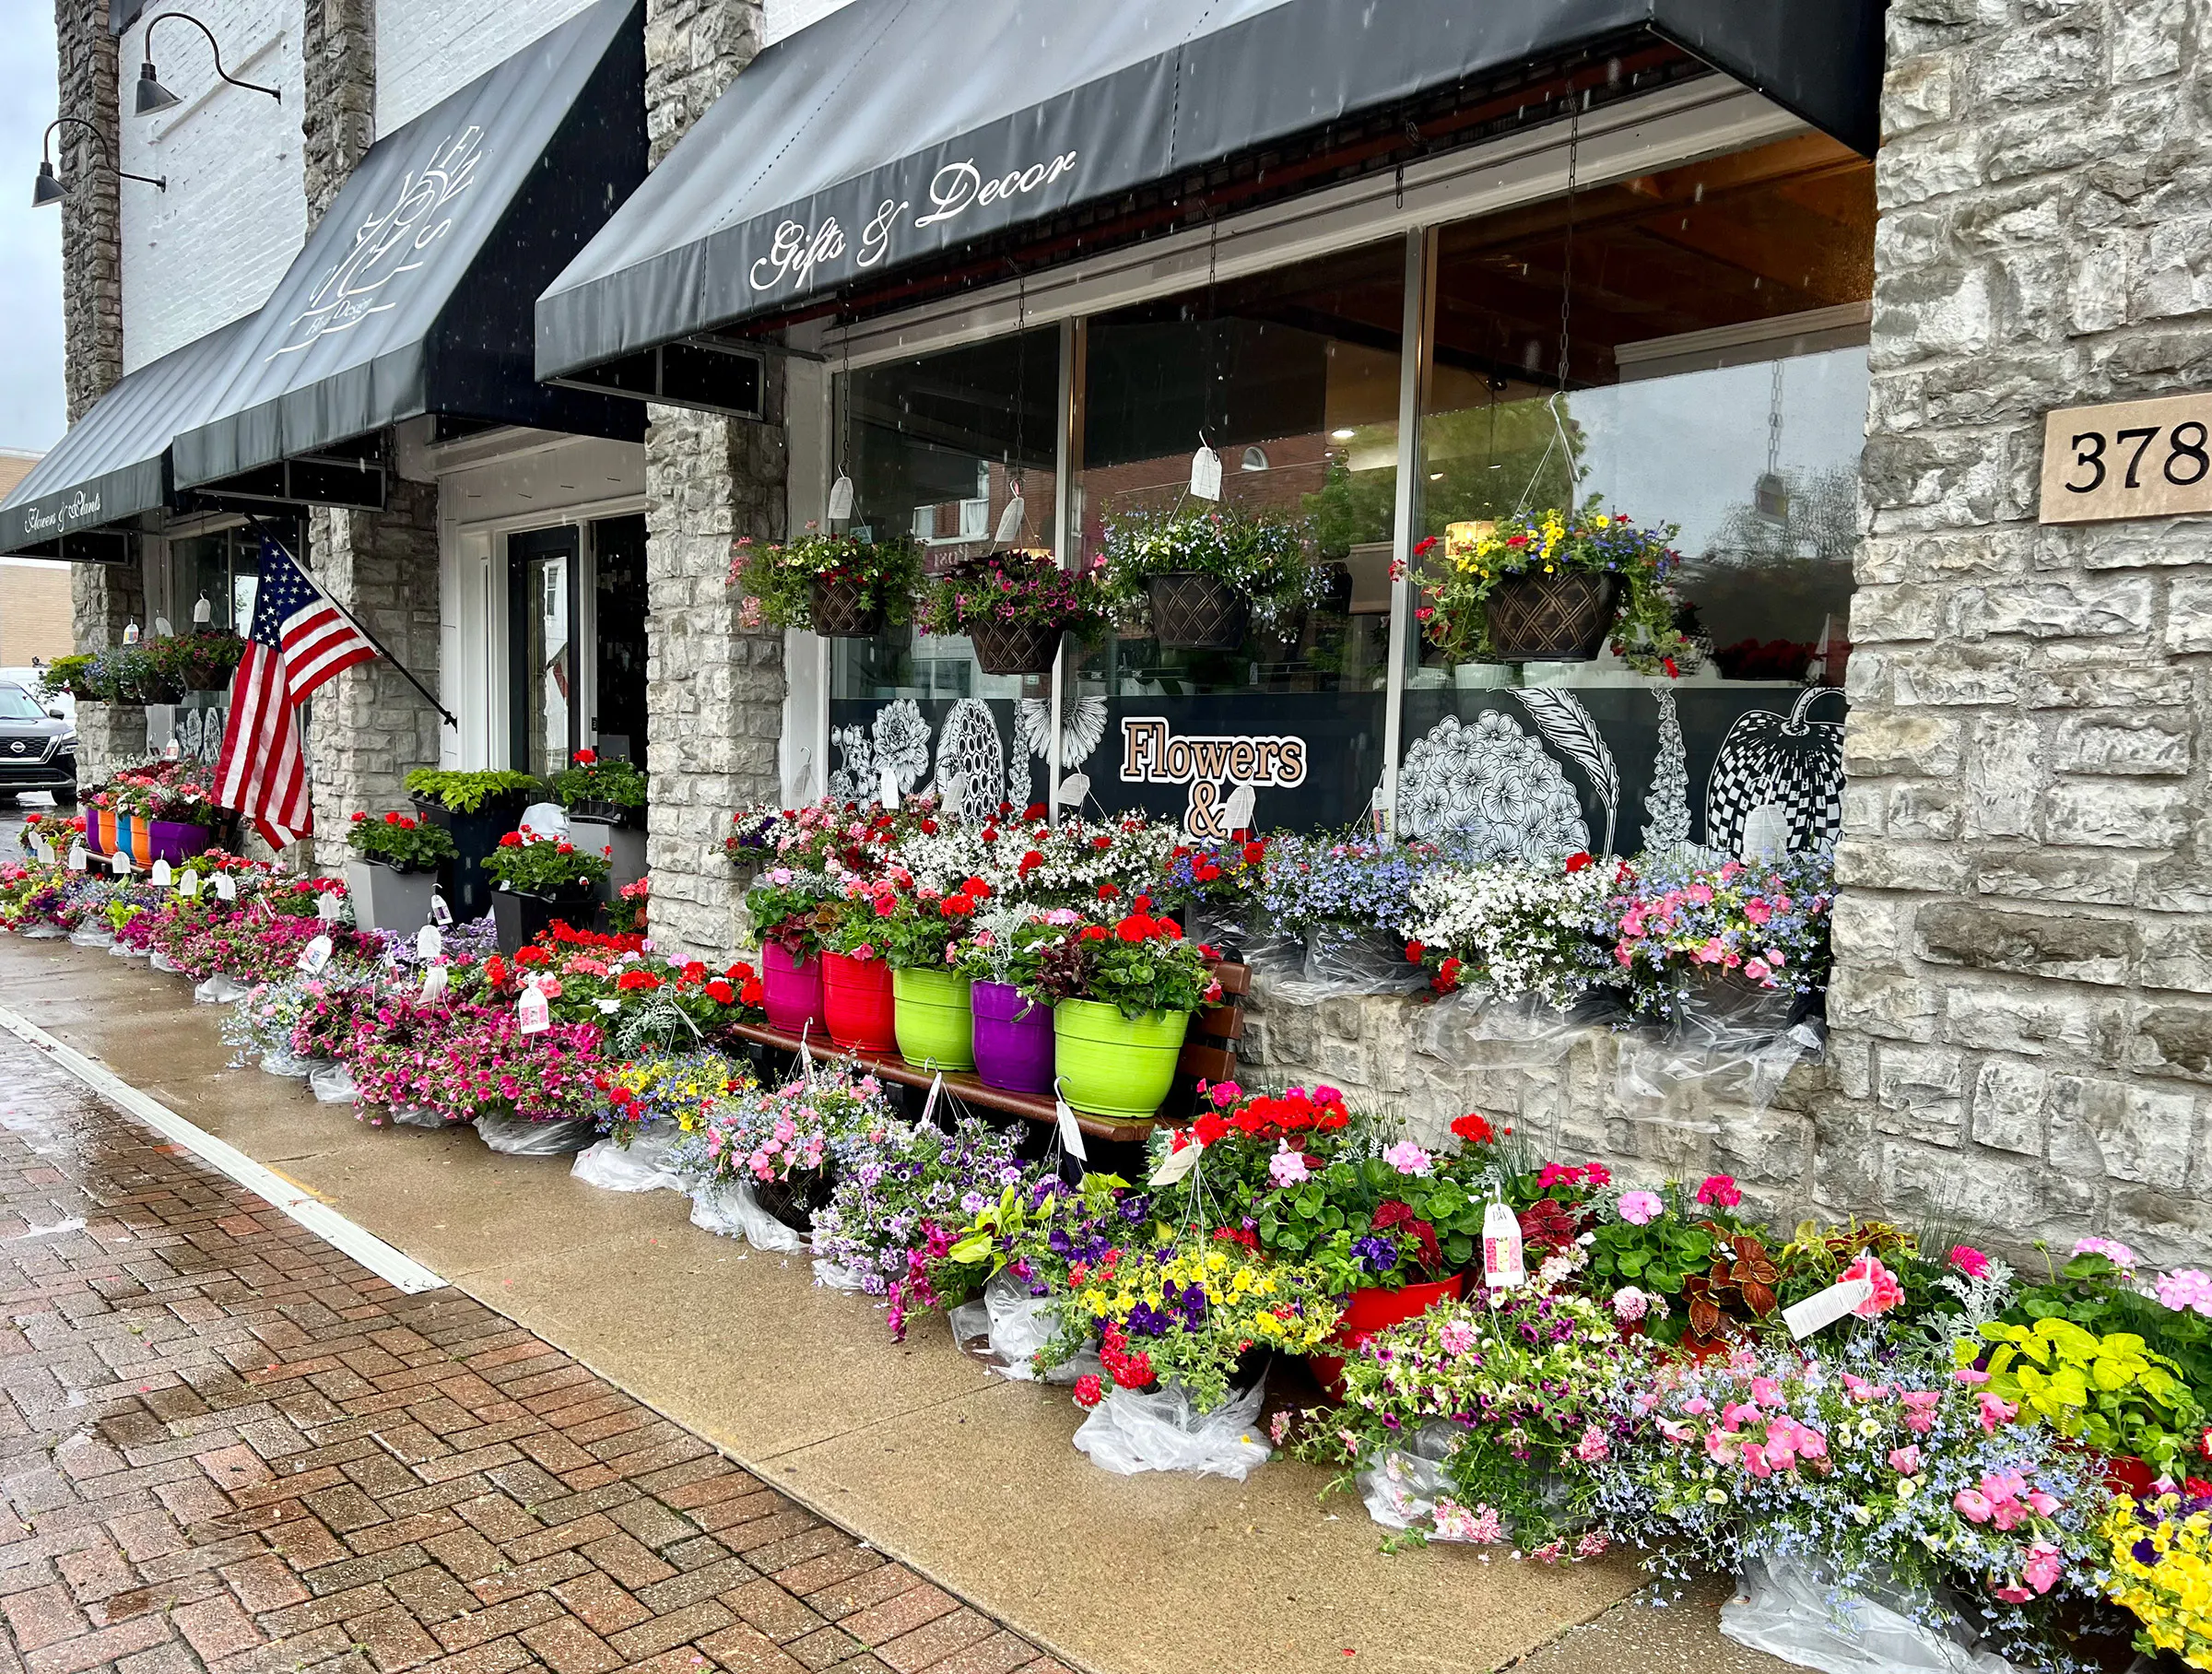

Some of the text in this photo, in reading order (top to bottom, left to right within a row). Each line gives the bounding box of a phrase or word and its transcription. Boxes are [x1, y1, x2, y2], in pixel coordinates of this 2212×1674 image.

[749, 150, 1077, 290] Gifts & Decor
[2065, 421, 2210, 493] 378
[1123, 720, 1304, 783] Flowers
[1187, 780, 1227, 840] &
